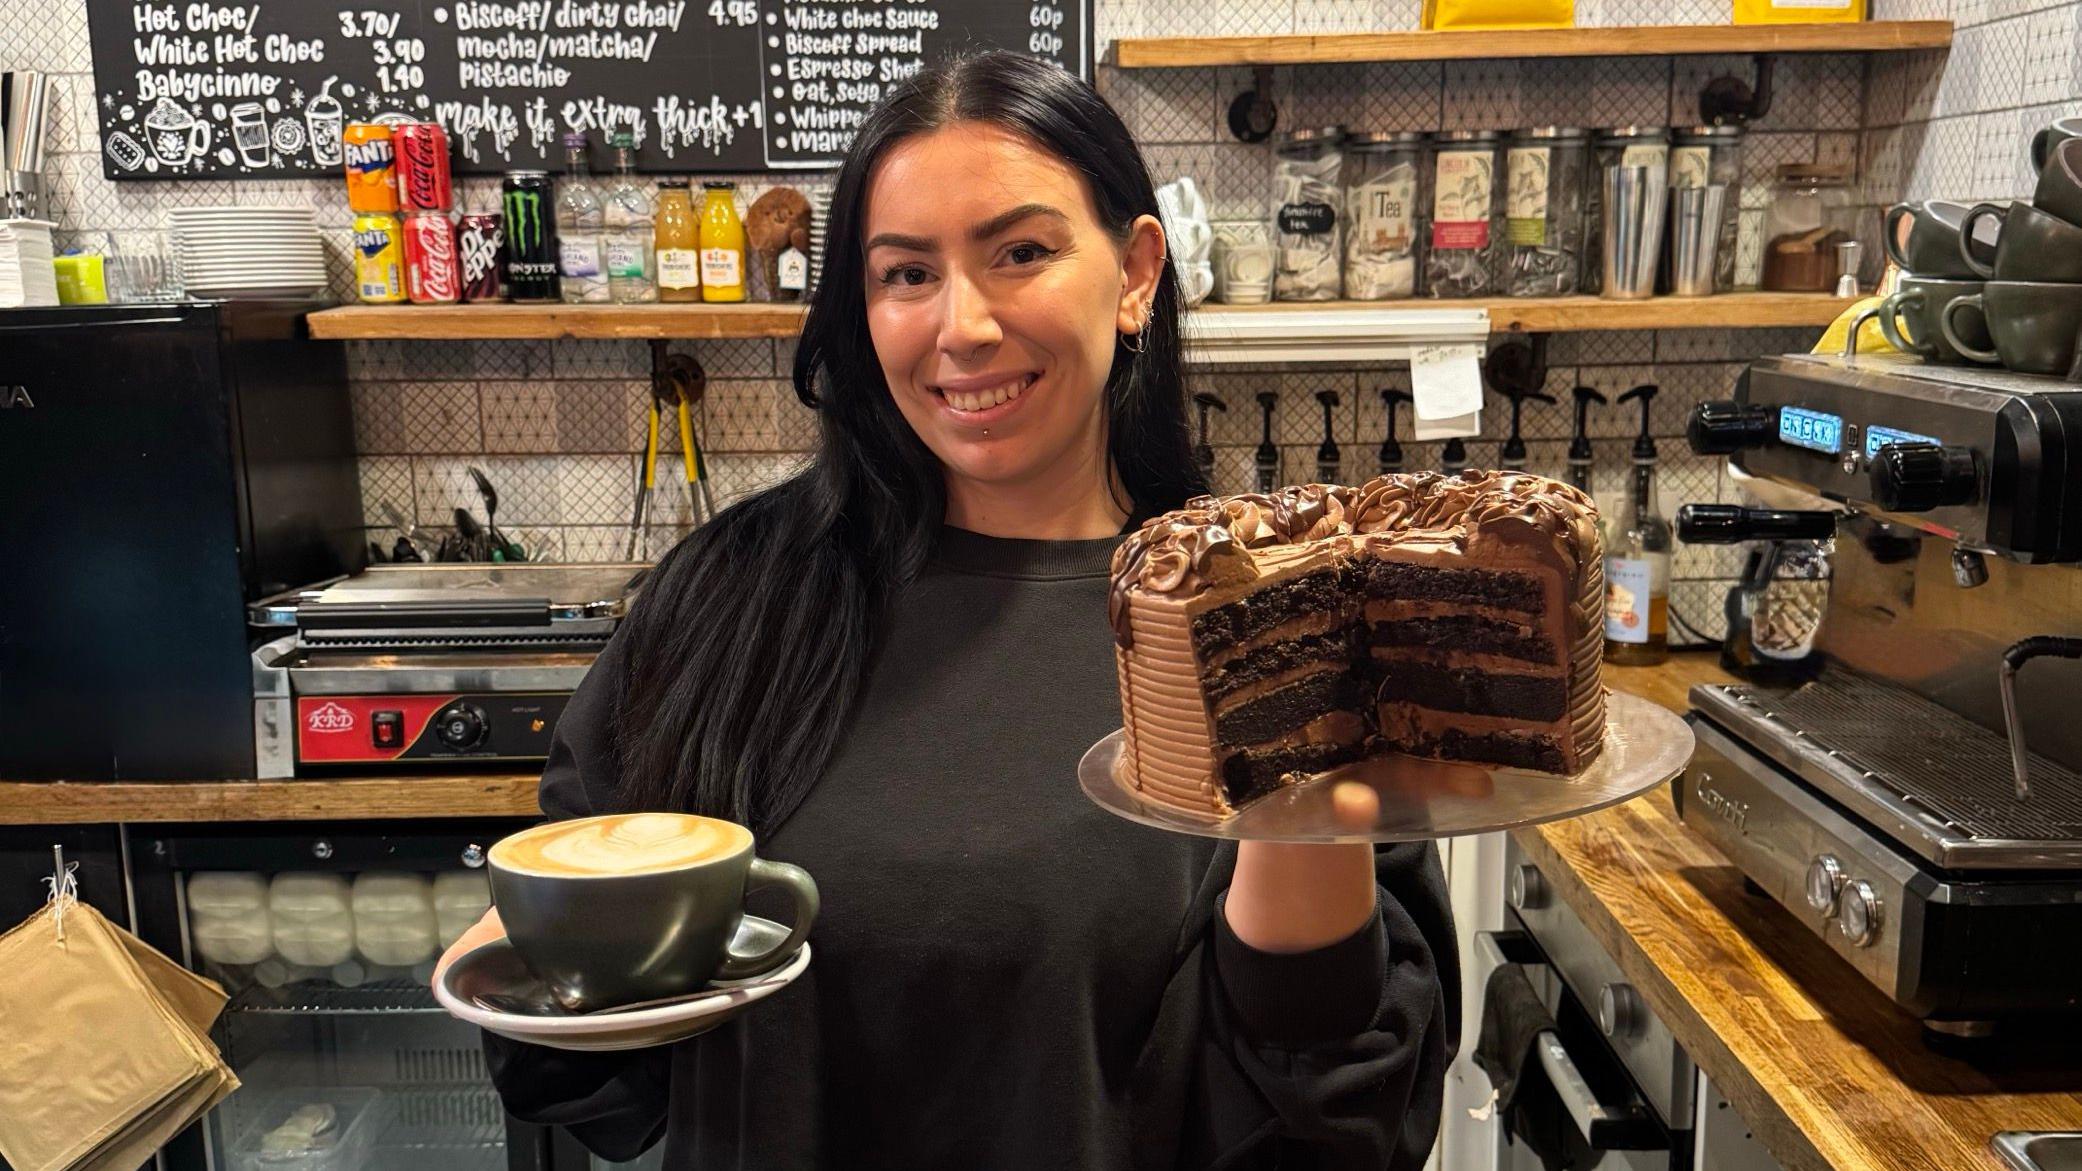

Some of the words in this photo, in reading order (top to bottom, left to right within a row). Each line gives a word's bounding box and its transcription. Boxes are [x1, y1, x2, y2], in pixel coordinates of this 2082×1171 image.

[133, 4, 180, 33] Hot
[186, 3, 260, 34] Choc/
[338, 10, 400, 38] 3.70/
[455, 1, 550, 31] Biscoff/
[554, 0, 620, 28] dirty
[624, 0, 685, 32] chai/
[708, 0, 758, 27] 4.95
[784, 7, 837, 31] White
[885, 7, 939, 30] Sauce
[1029, 4, 1064, 31] 60p
[134, 34, 209, 65] White
[215, 34, 258, 63] Hot
[265, 33, 324, 64] Choc
[373, 38, 425, 64] 3.90
[785, 31, 852, 55] Biscoff
[854, 29, 923, 55] Spread
[1029, 31, 1063, 56] 60p
[135, 66, 281, 101] Babycinno
[376, 64, 424, 93] 1.40
[787, 57, 875, 80] Espresso
[879, 57, 924, 82] Shot
[435, 95, 519, 146] make
[525, 96, 555, 146] it
[560, 95, 647, 144] extra
[652, 95, 734, 146] thick
[790, 105, 862, 129] Whippe
[1375, 191, 1401, 219] Tea
[461, 225, 485, 260] Dr
[309, 714, 354, 728] KRD
